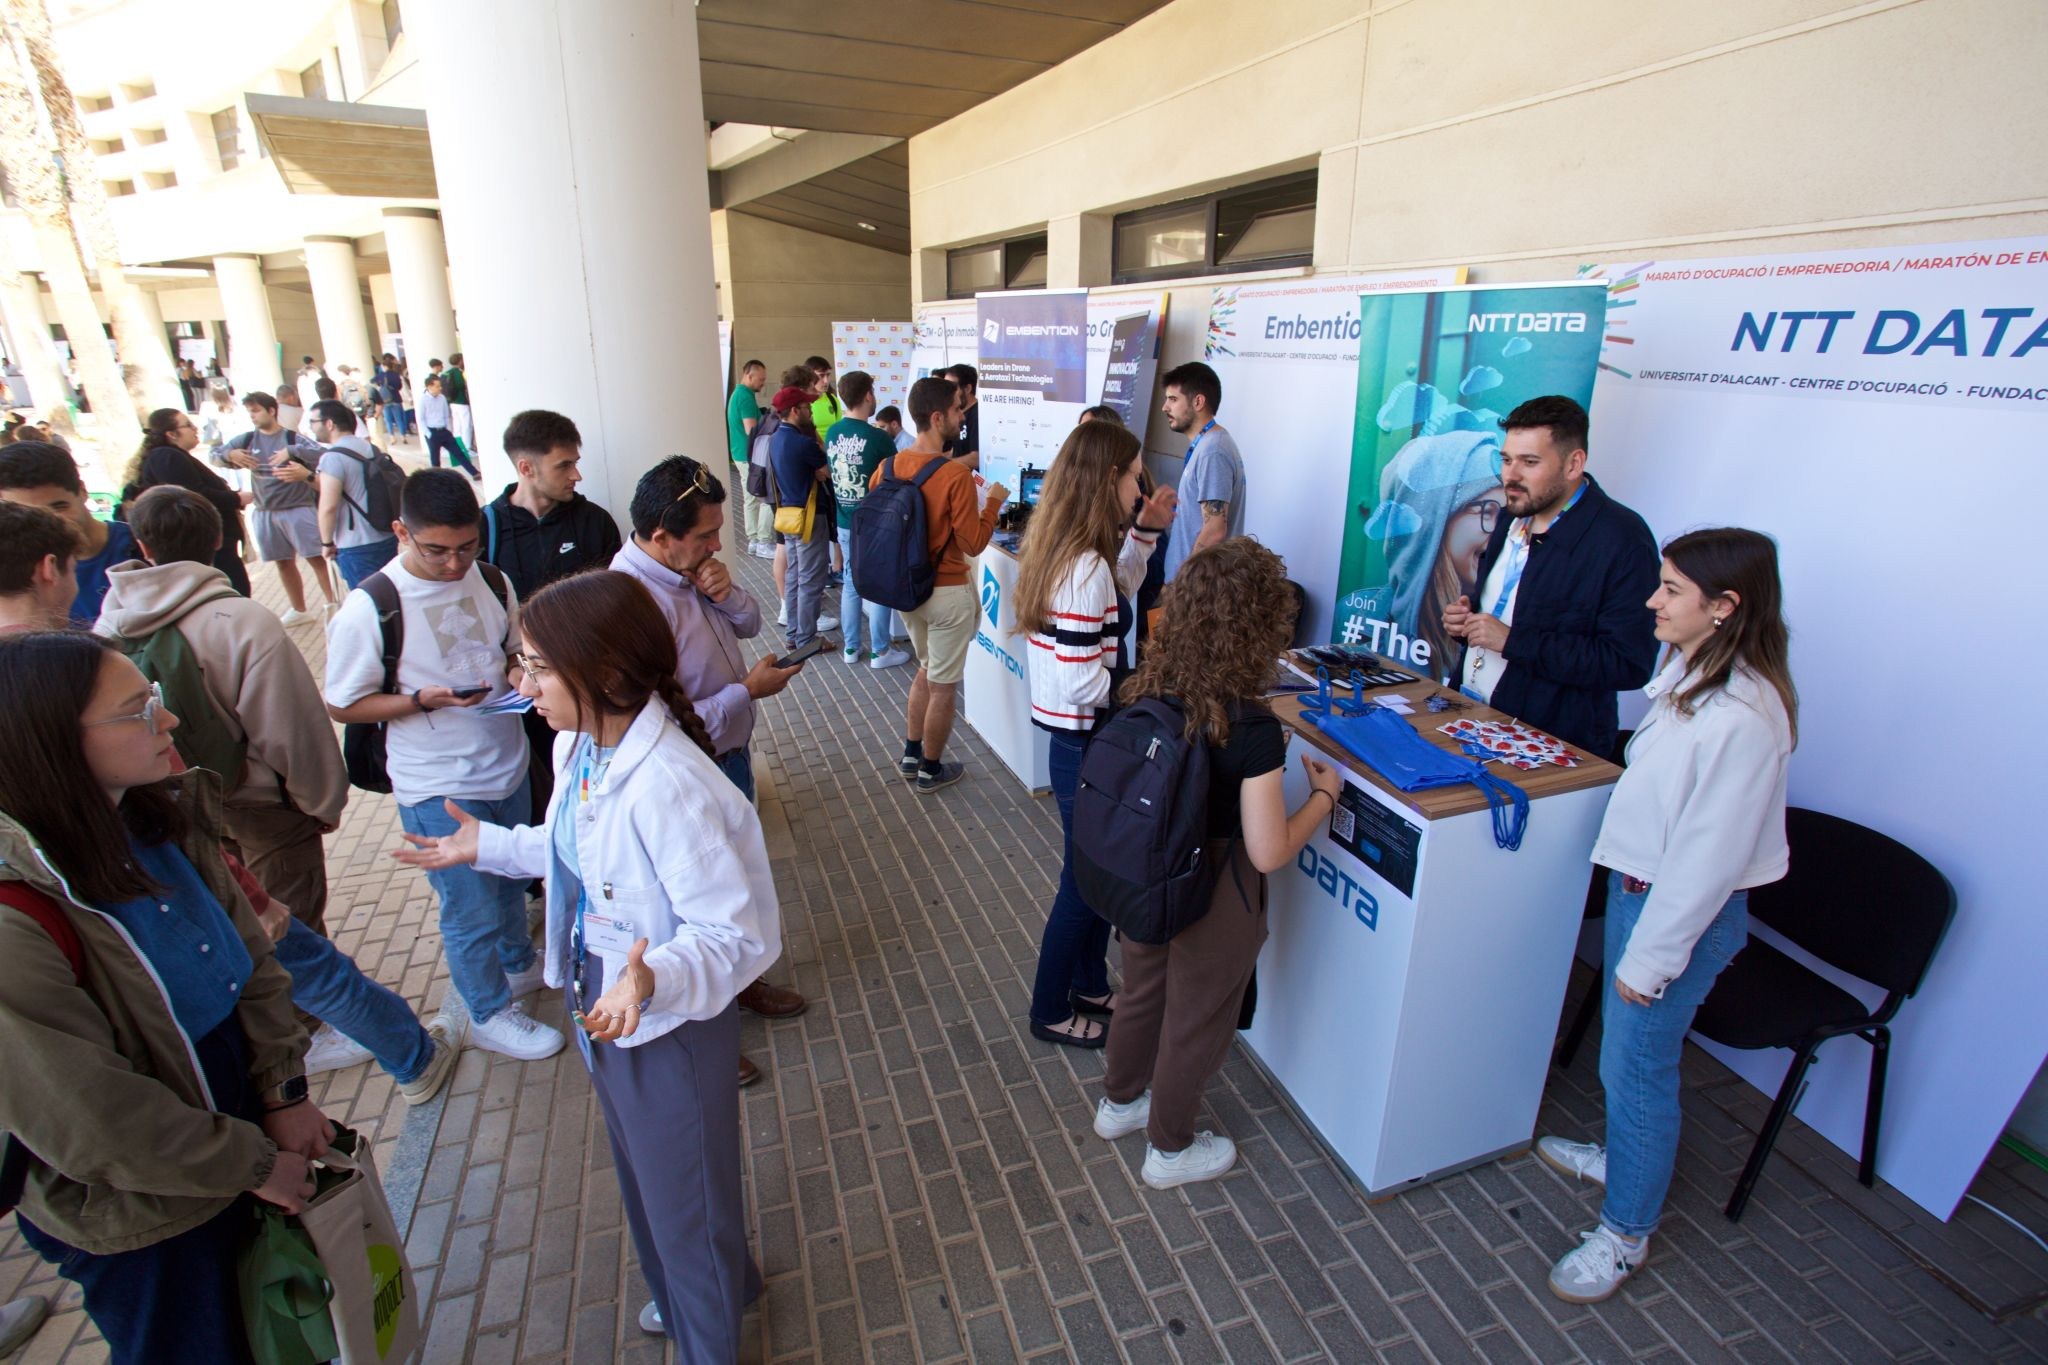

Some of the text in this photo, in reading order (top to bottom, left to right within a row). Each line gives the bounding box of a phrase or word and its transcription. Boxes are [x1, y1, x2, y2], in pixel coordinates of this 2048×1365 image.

[1645, 269, 1691, 281] MARATÓ
[1693, 265, 1767, 280] D'OCUPACIÓ
[1776, 261, 1890, 276] EMPRENEDORIA
[1904, 252, 1993, 270] MARATÓN
[1995, 252, 2024, 266] DE
[1006, 325, 1079, 336] EMBENTION
[1265, 310, 1361, 340] Embentio
[1468, 313, 1516, 333] NTT
[1730, 308, 2048, 357] NTT DATA
[980, 362, 1031, 373] Leaders in Drone
[984, 373, 1011, 382] Aerotaxi
[1011, 374, 1054, 386] Technologies
[1639, 370, 1708, 383] UNIVERSITAT
[1710, 373, 1780, 387] D'ALACANT
[1789, 377, 1845, 391] CENTRE
[1847, 380, 1948, 396] D'OCUPACIÓ
[983, 394, 1035, 406] WE ARE HIRING!
[1345, 592, 1377, 612] Join
[1341, 614, 1431, 666] #The
